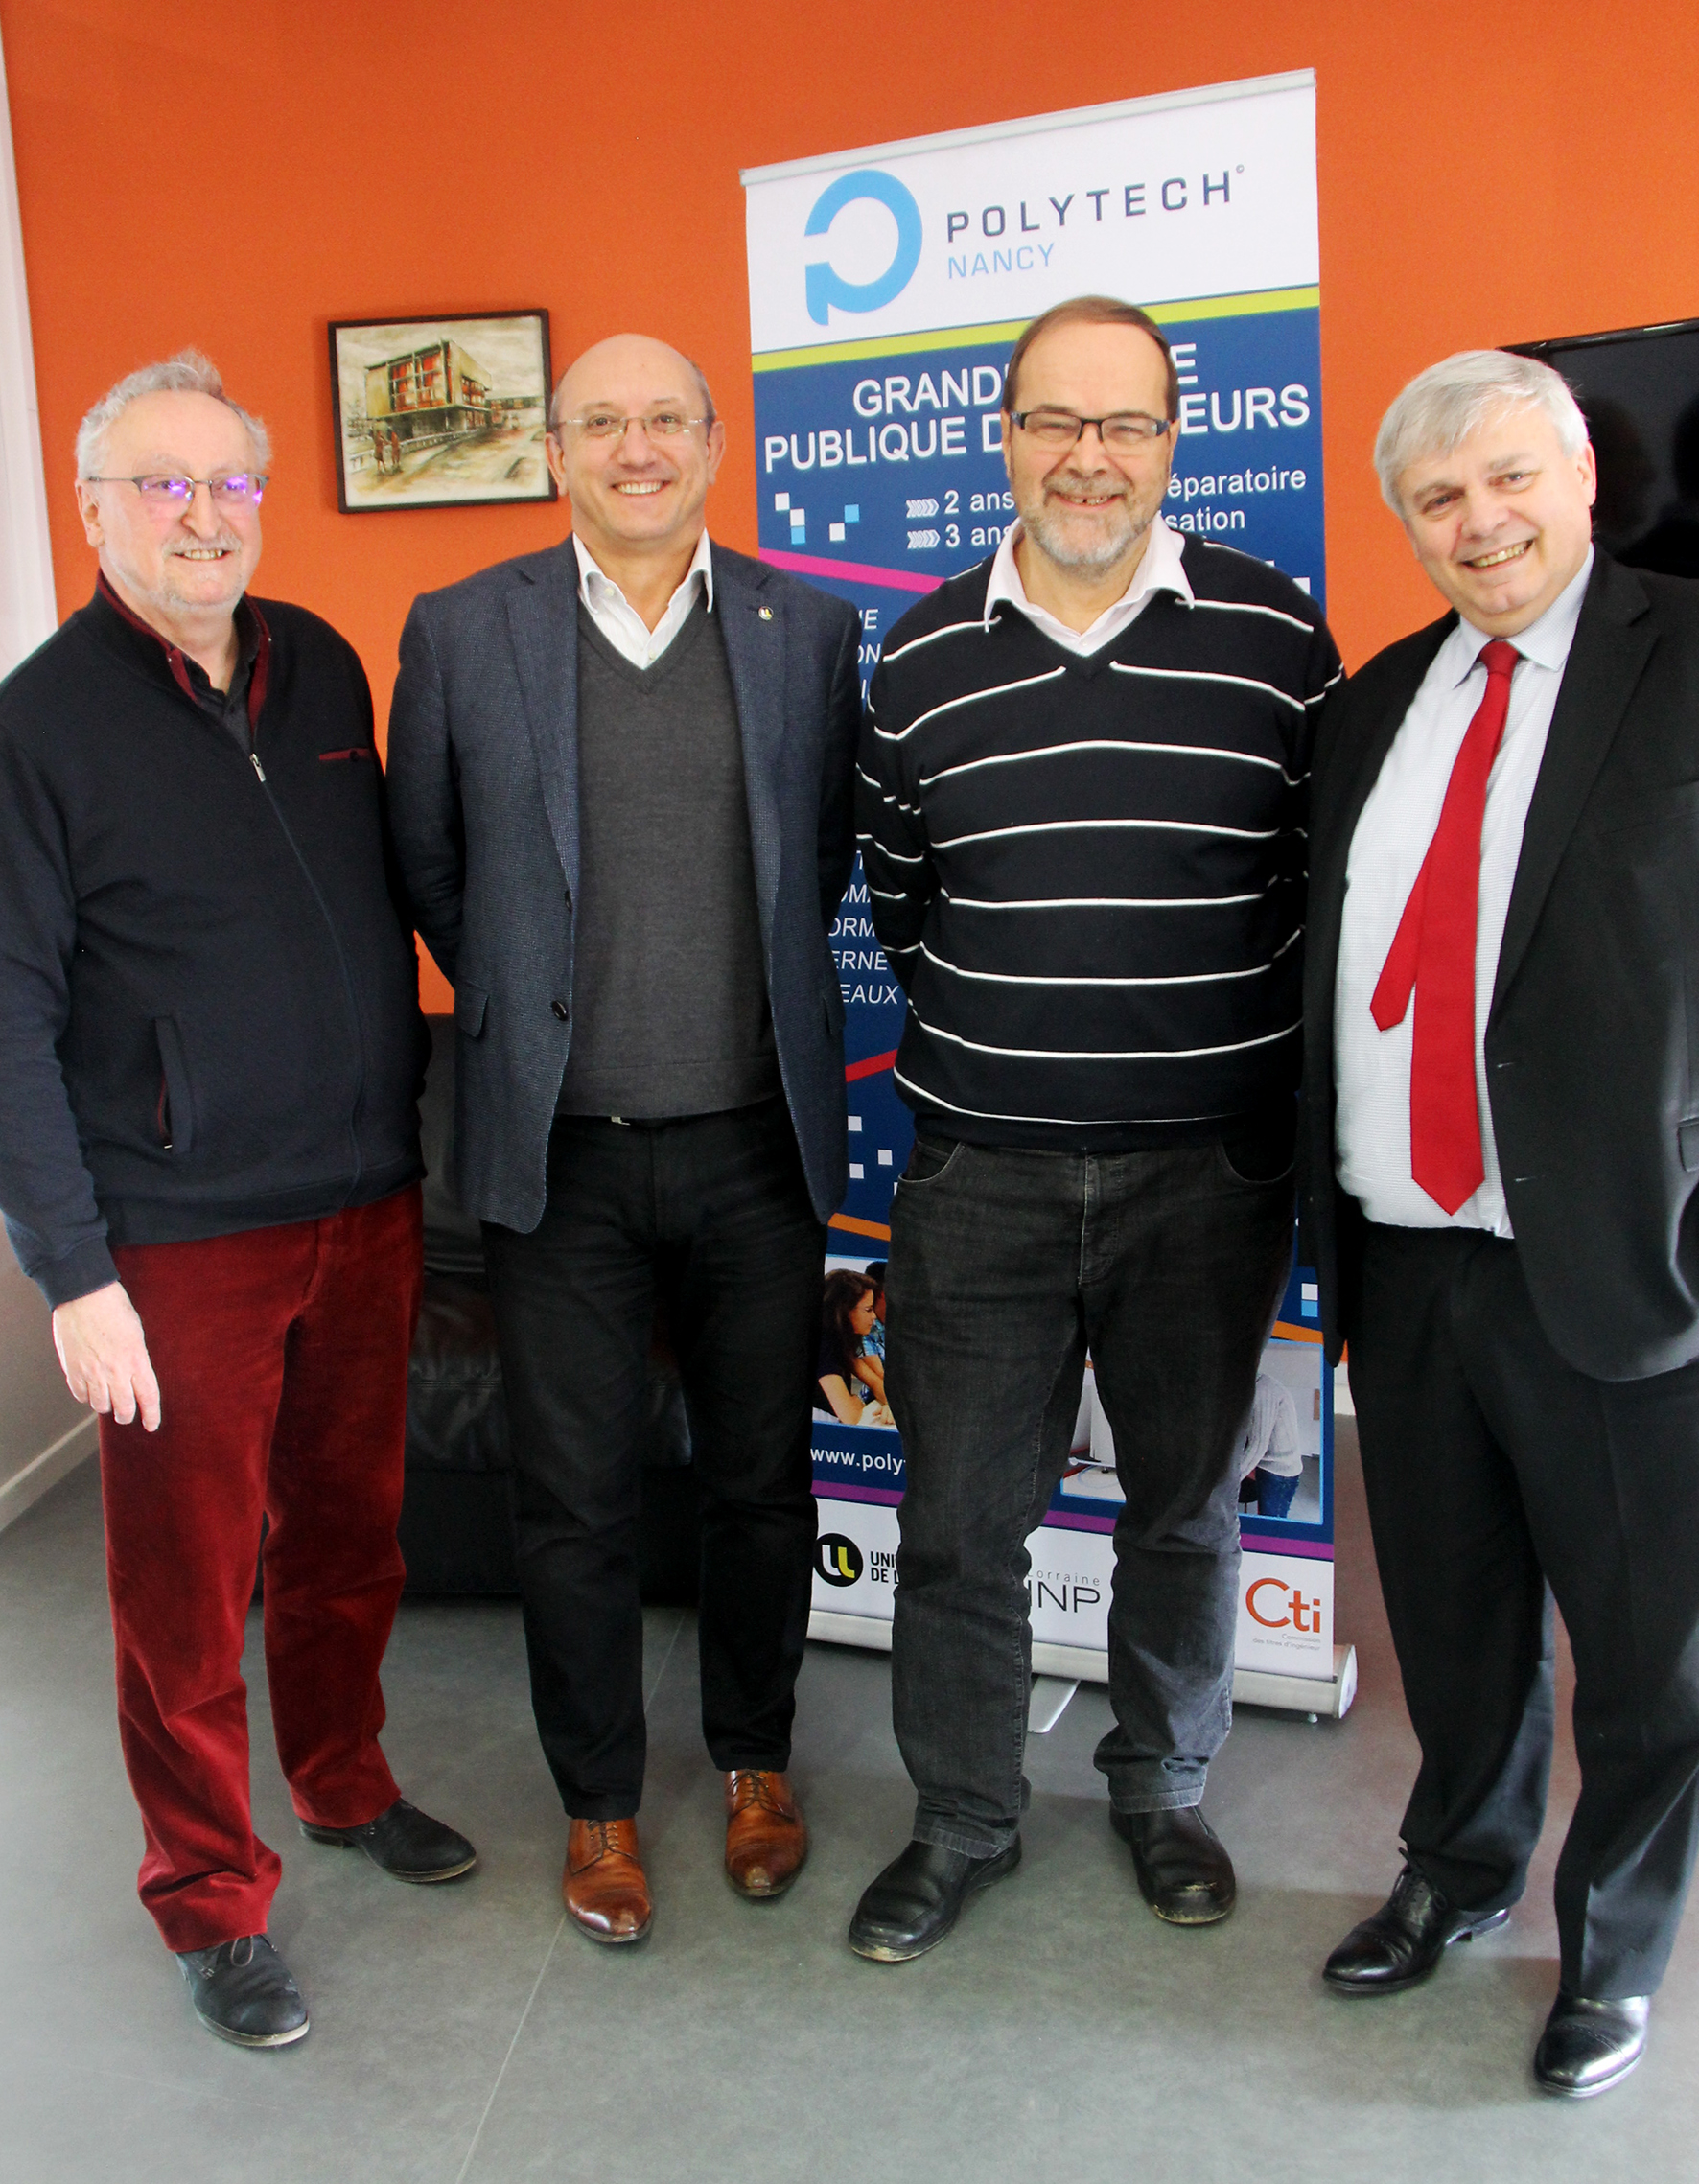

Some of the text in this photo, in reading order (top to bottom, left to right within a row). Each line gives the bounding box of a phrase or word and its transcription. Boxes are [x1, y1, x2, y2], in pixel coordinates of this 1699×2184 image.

[947, 170, 1230, 243] POLYTECH
[948, 243, 1055, 279] NANCY
[852, 363, 1010, 417] GRAND
[764, 415, 967, 474] PUBLIQUE
[944, 489, 959, 514] 2
[970, 491, 1015, 512] ans
[945, 523, 960, 548] 3
[1160, 506, 1245, 533] sation
[810, 1448, 906, 1475] www.poly
[1245, 1577, 1320, 1633] Cti
